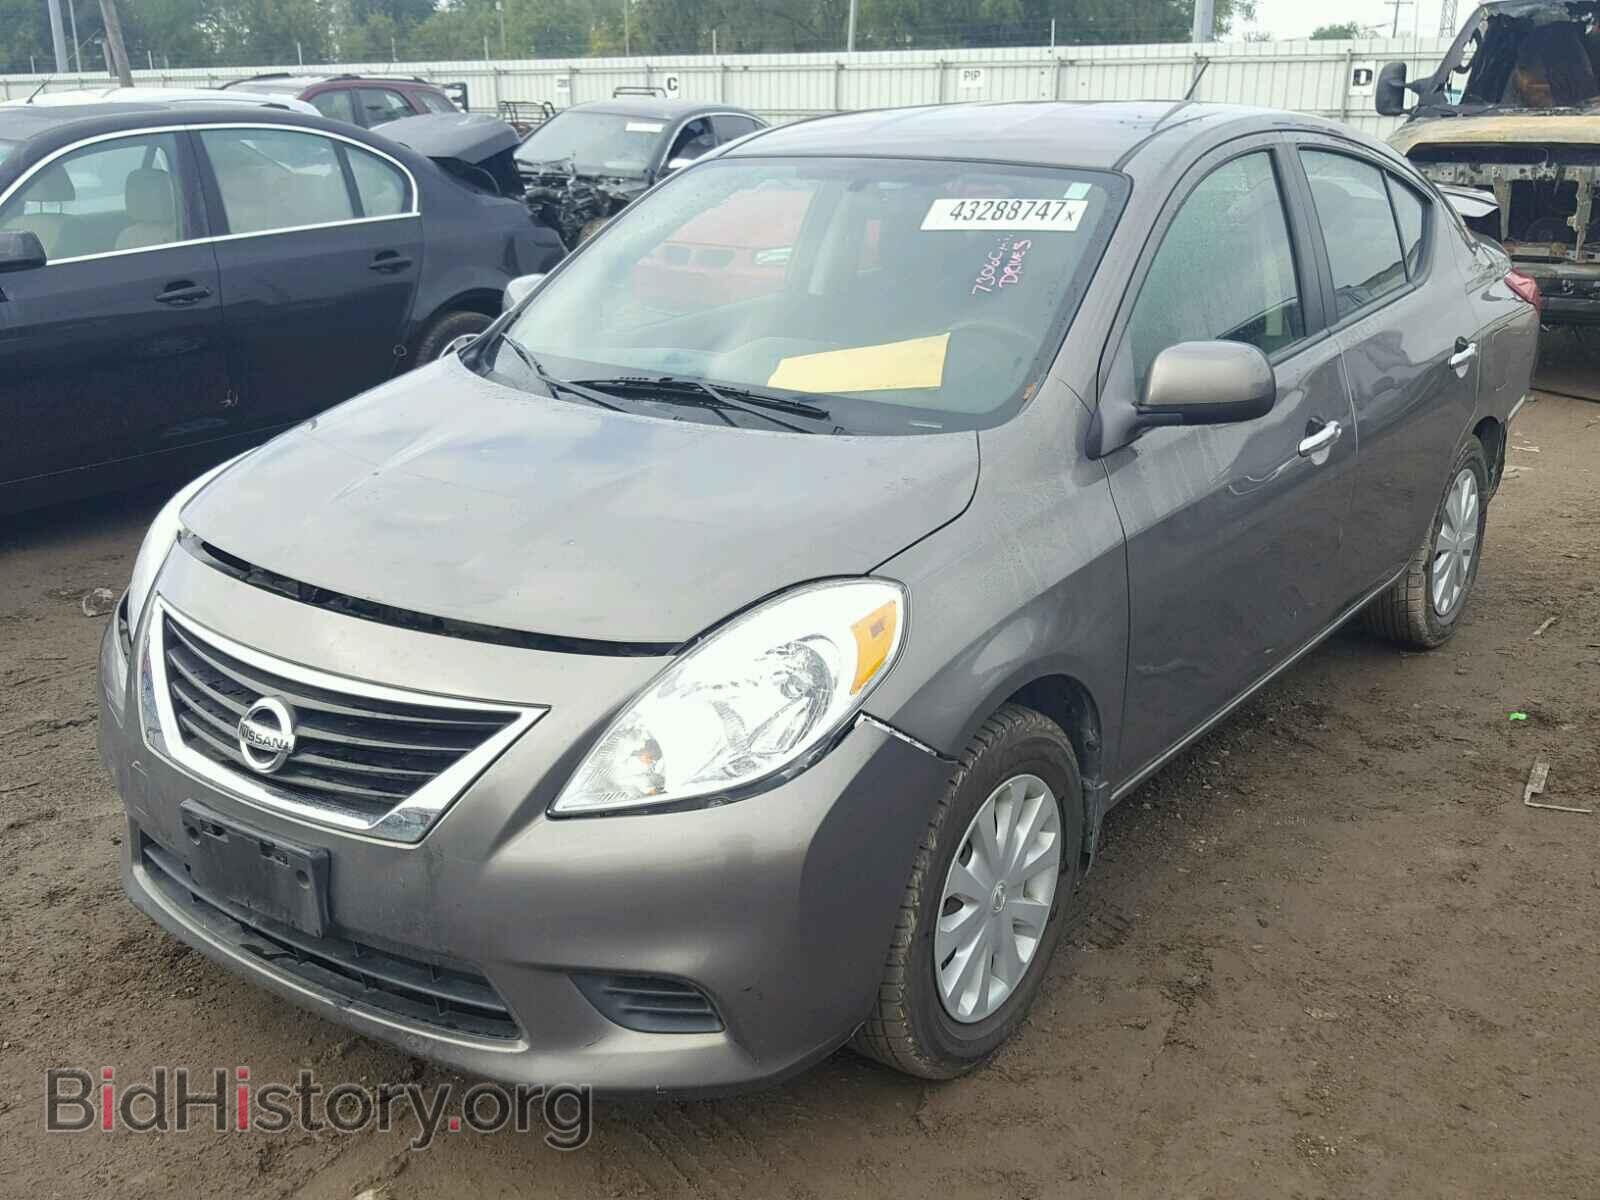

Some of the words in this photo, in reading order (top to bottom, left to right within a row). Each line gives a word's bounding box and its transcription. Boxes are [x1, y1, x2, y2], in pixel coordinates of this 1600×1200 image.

[667, 77, 678, 91] C
[963, 70, 981, 81] PIP
[1353, 69, 1373, 86] D
[949, 200, 1067, 221] 43288747
[239, 720, 291, 751] NISSAN
